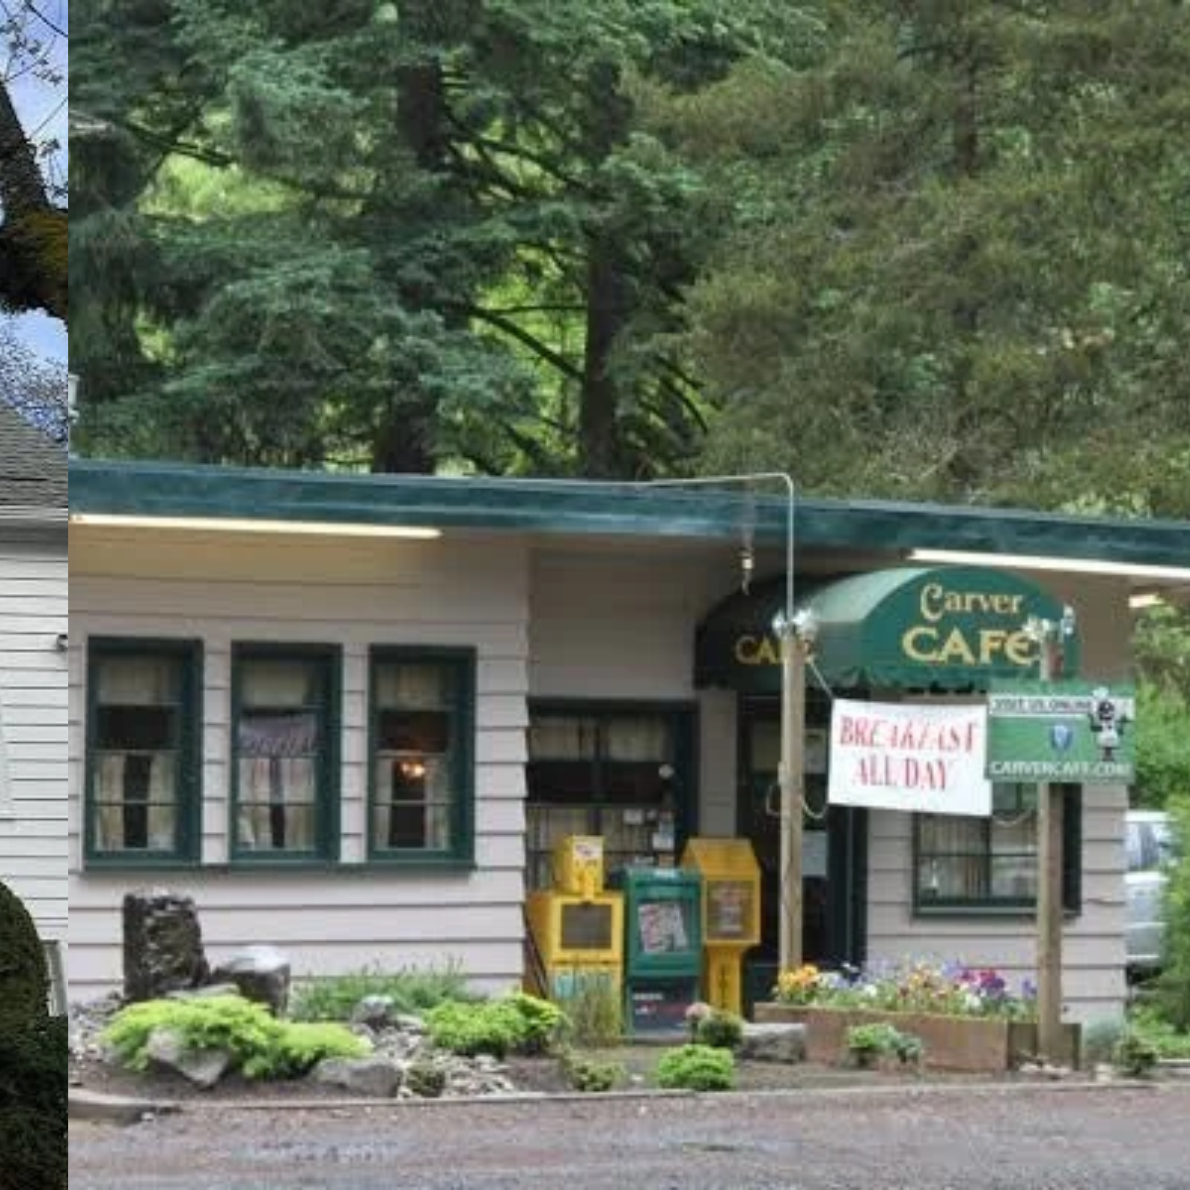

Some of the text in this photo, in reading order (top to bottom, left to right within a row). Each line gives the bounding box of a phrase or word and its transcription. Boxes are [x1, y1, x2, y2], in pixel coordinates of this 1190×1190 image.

[920, 583, 1023, 621] Carver
[736, 635, 813, 665] CA
[839, 714, 978, 753] BREAKFAST
[853, 754, 952, 792] ALL DAY
